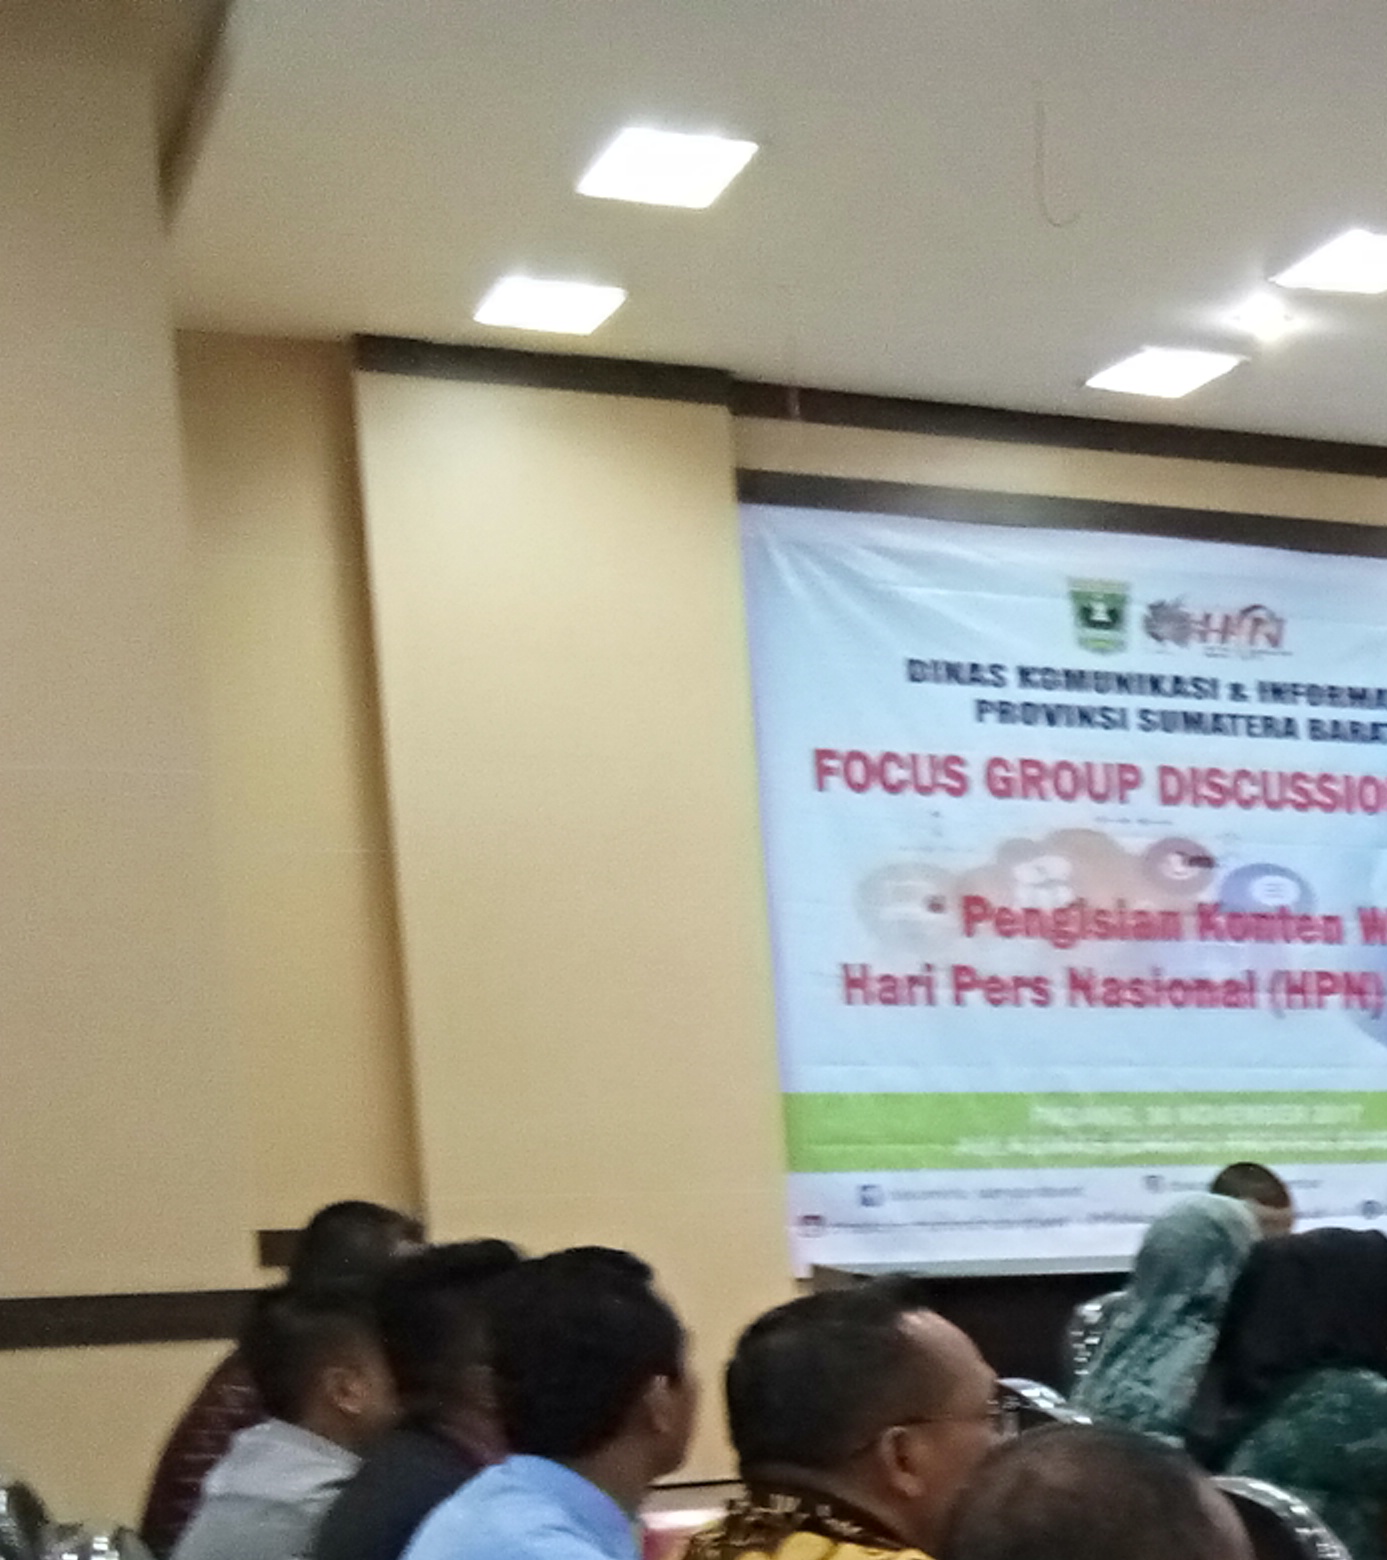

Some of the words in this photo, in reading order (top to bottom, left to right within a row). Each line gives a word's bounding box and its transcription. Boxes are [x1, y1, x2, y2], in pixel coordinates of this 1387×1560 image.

[904, 657, 1007, 689] DINAS
[1016, 664, 1219, 702] KOMUNIKASI
[972, 698, 1129, 731] PROVINSI
[1135, 707, 1302, 741] SUMATERA
[812, 747, 970, 798] FOCUS
[985, 756, 1146, 805] GROUP
[958, 893, 1184, 949] Pengisian
[1196, 901, 1344, 945] Konten
[841, 962, 938, 1007] Hari
[950, 963, 1054, 1008] Pers
[1067, 965, 1257, 1010] Nasional
[1269, 967, 1385, 1020] (HPN)
